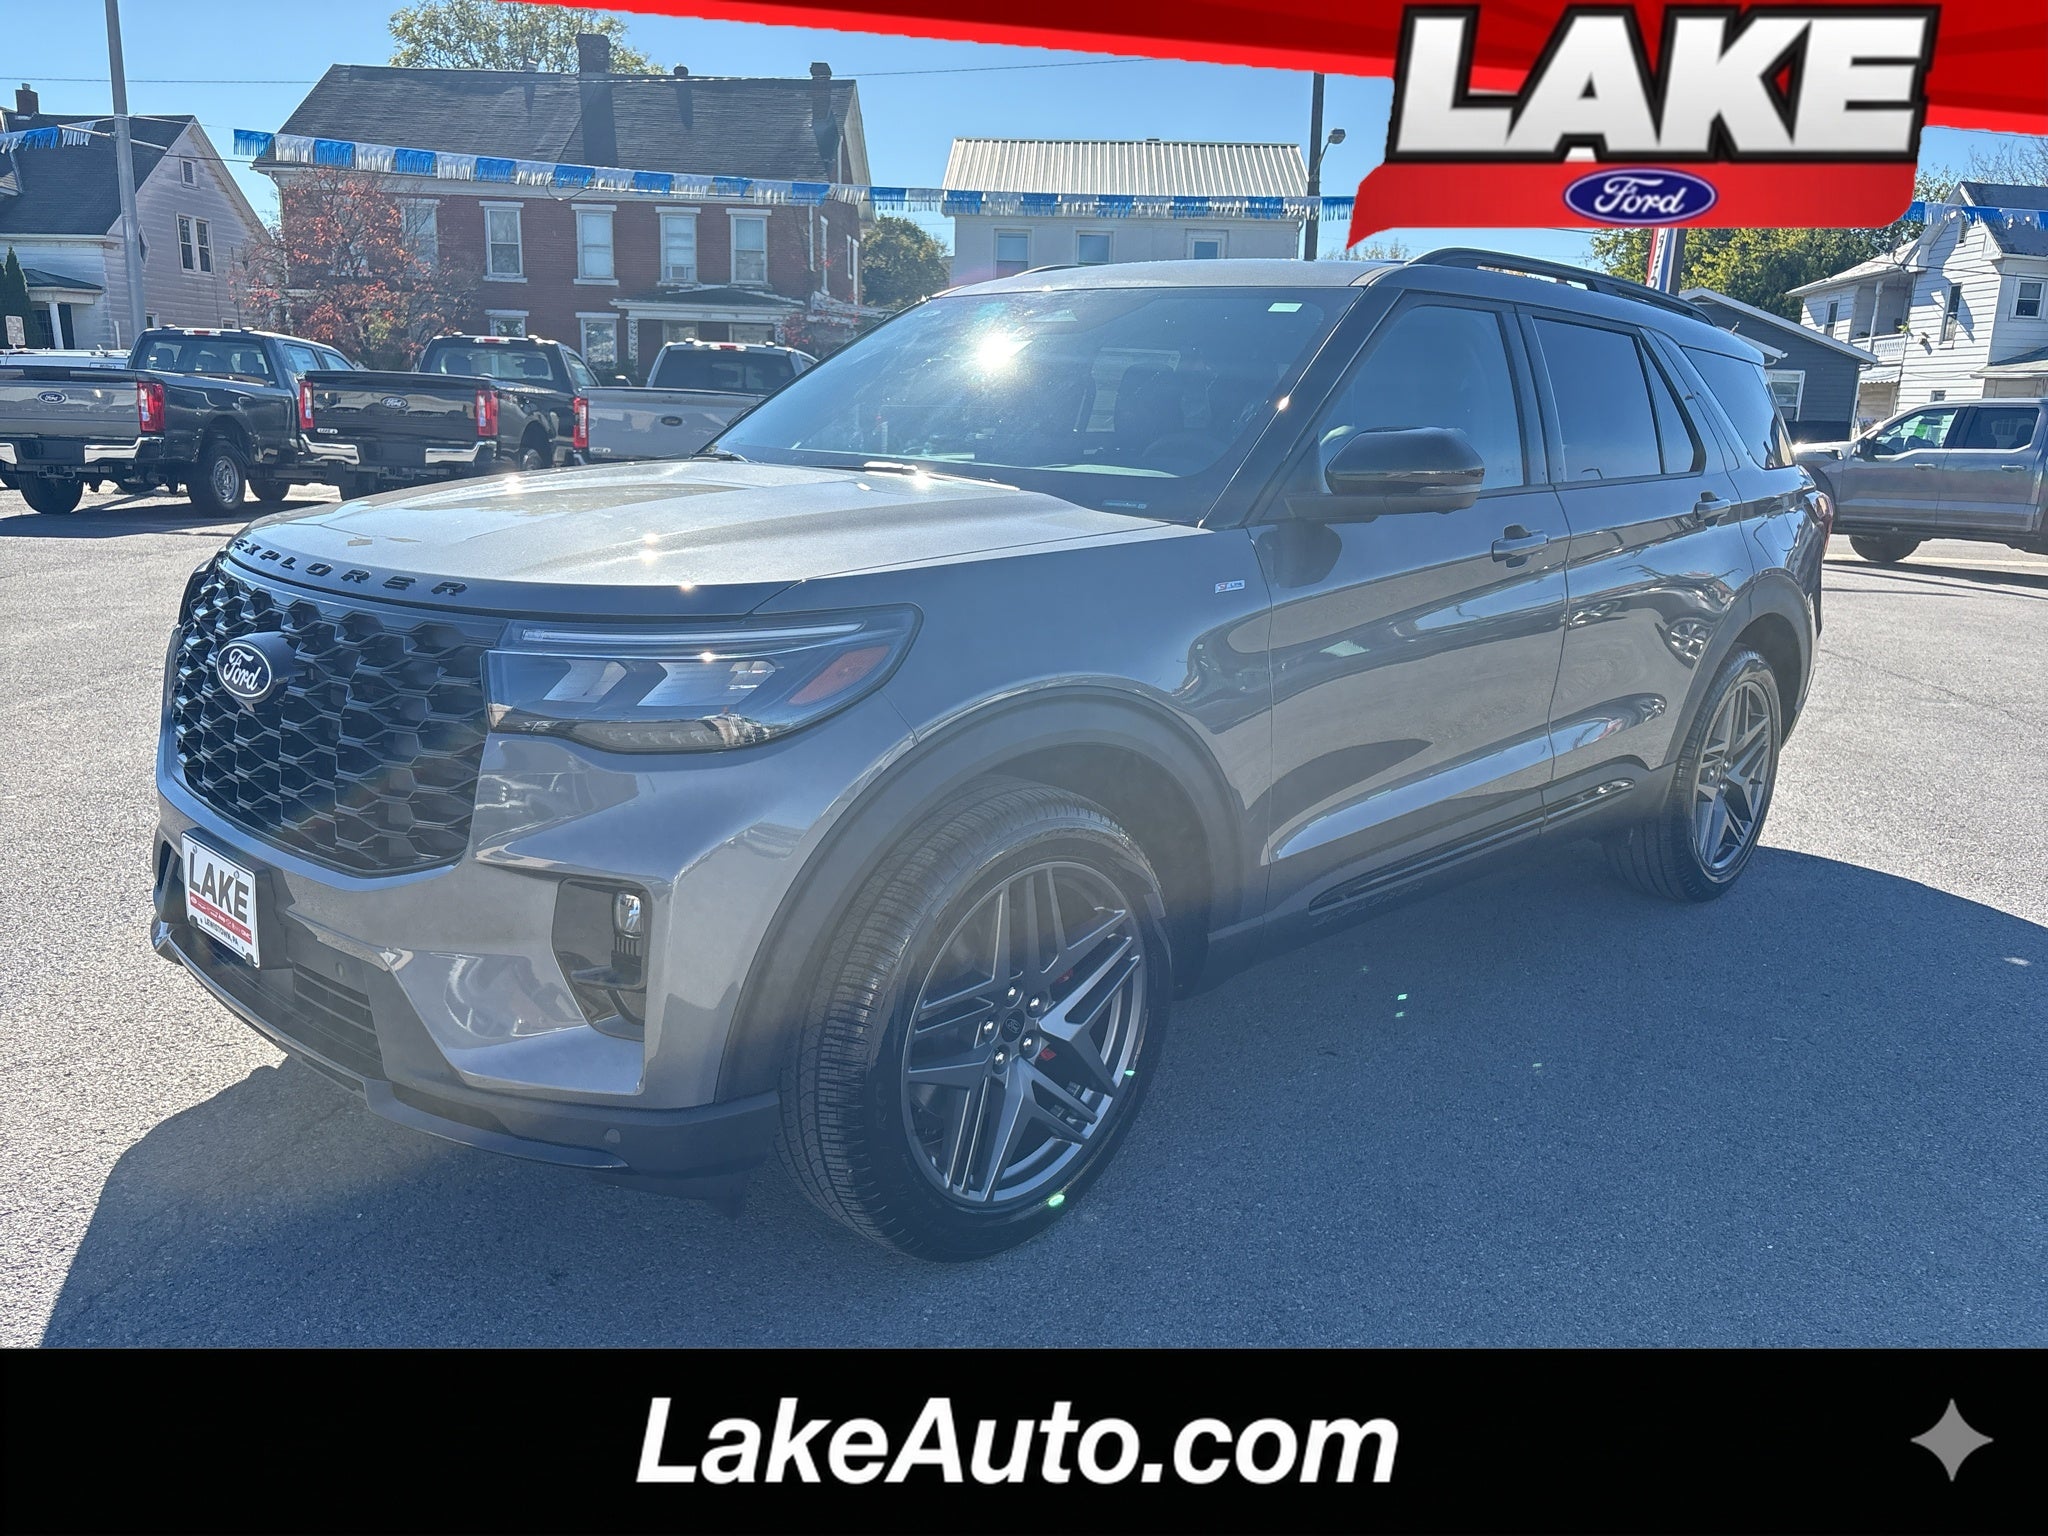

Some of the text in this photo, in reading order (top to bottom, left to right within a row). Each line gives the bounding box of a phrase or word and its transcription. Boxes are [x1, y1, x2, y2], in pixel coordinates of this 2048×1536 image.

[233, 538, 468, 597] EXPLORER
[223, 648, 262, 691] Ford
[189, 851, 249, 924] LAKE
